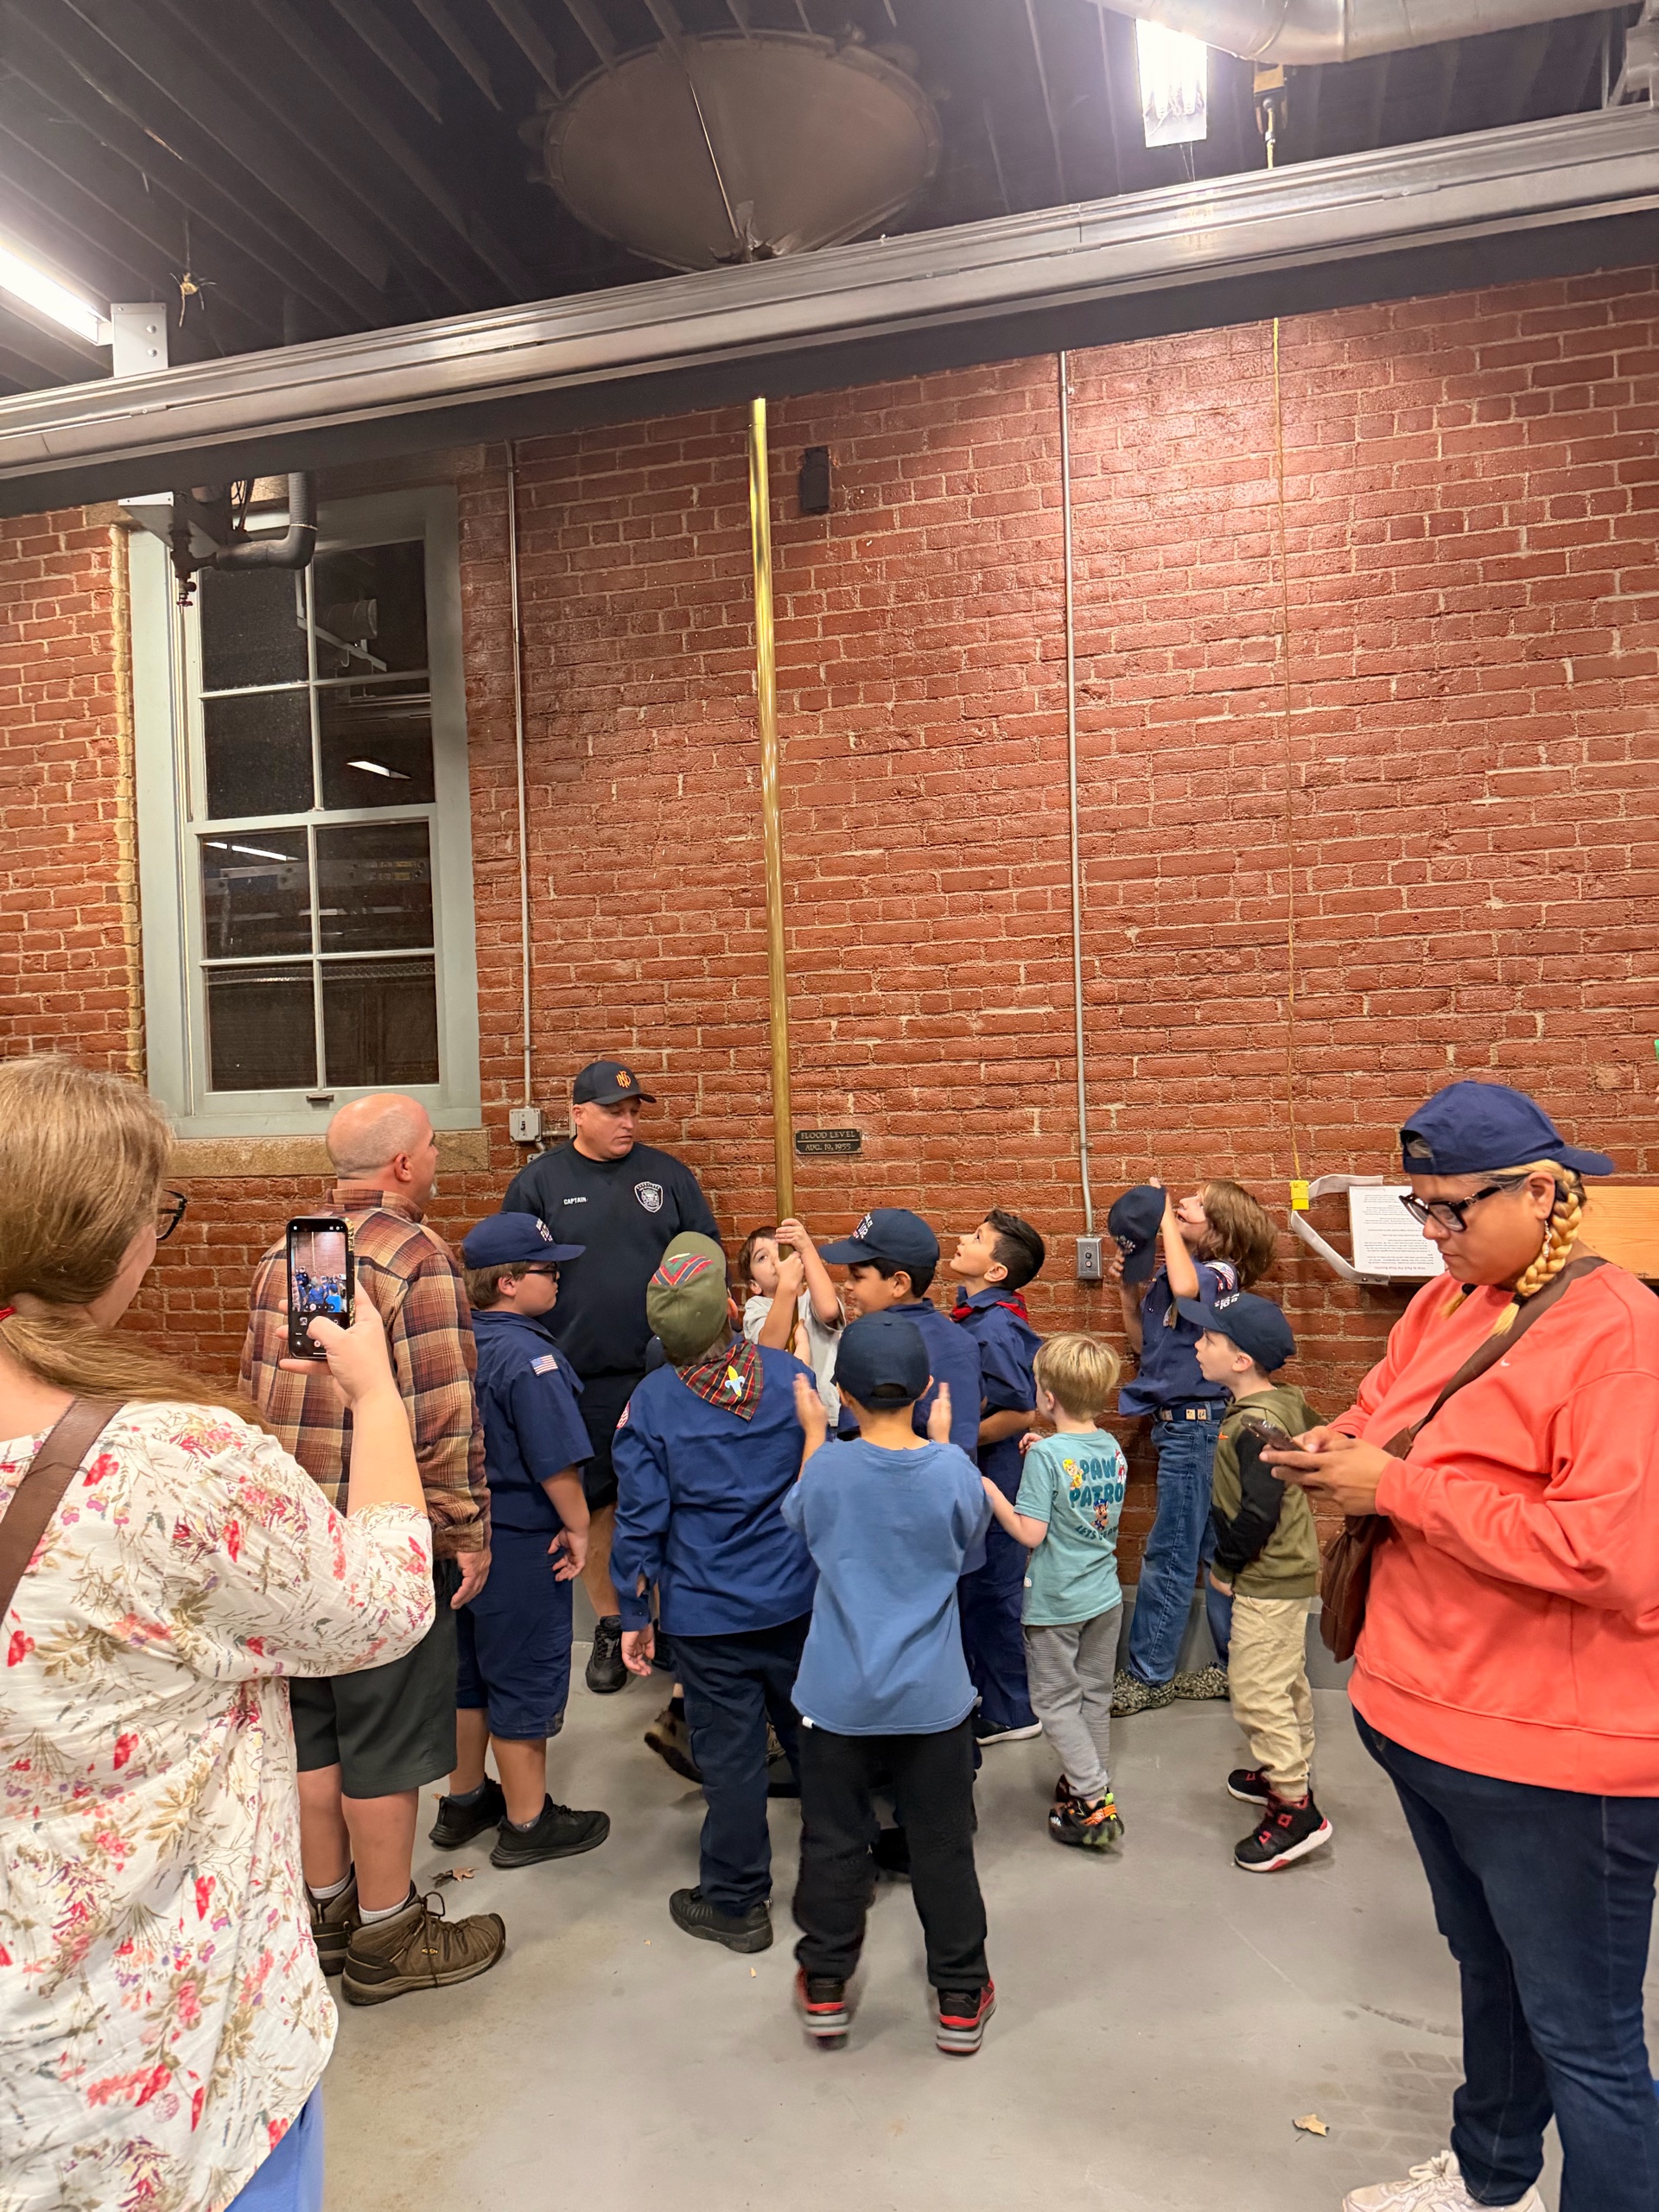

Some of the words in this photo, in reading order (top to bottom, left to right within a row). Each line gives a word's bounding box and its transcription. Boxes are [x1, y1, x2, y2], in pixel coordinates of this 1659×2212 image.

[835, 1143, 851, 1152] 1955
[563, 1197, 587, 1205] CAPTAIN
[1079, 1456, 1116, 1481] PAW
[1069, 1483, 1123, 1509] PATRO
